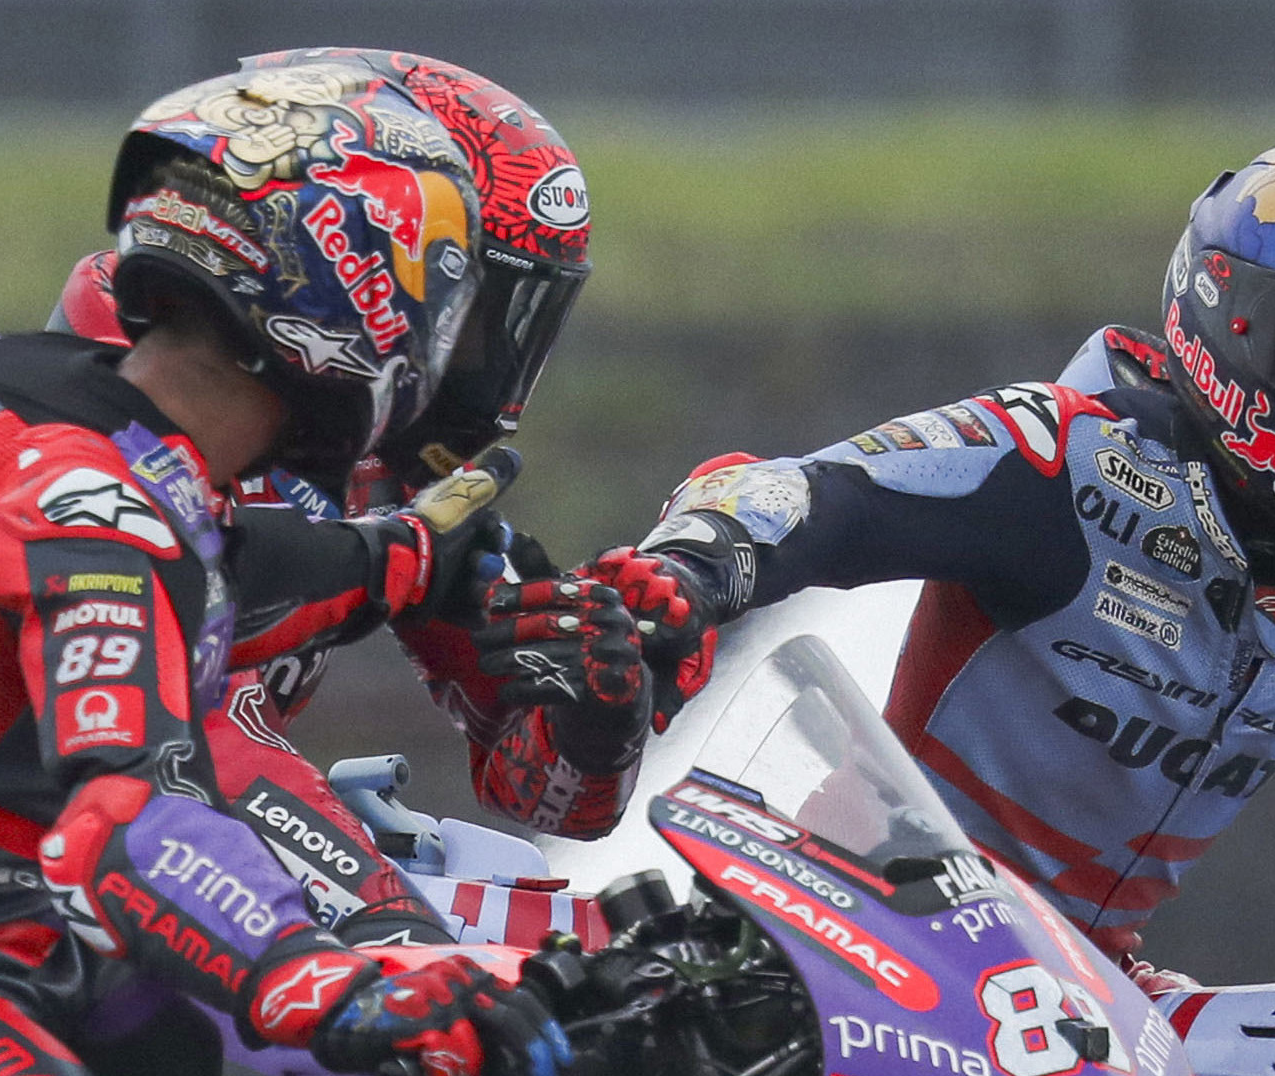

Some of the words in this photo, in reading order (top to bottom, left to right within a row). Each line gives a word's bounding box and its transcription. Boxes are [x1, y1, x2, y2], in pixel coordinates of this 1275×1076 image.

[302, 193, 385, 290] Red
[1165, 300, 1201, 378] Red
[1194, 354, 1245, 427] Bull
[290, 479, 327, 518] TIM
[1105, 456, 1164, 504] SHOEI
[1075, 486, 1140, 546] OLI
[54, 603, 144, 633] MOTUL
[1098, 598, 1157, 635] Allianz
[56, 635, 140, 685] 89
[1051, 640, 1218, 707] GRESINI
[246, 791, 361, 877] Lenovo
[674, 787, 799, 842] WRS
[669, 808, 742, 847] LINO
[740, 840, 852, 909] SONEGO
[149, 839, 278, 940] prima
[720, 865, 909, 988] PRAMAC
[952, 902, 1020, 943] prim
